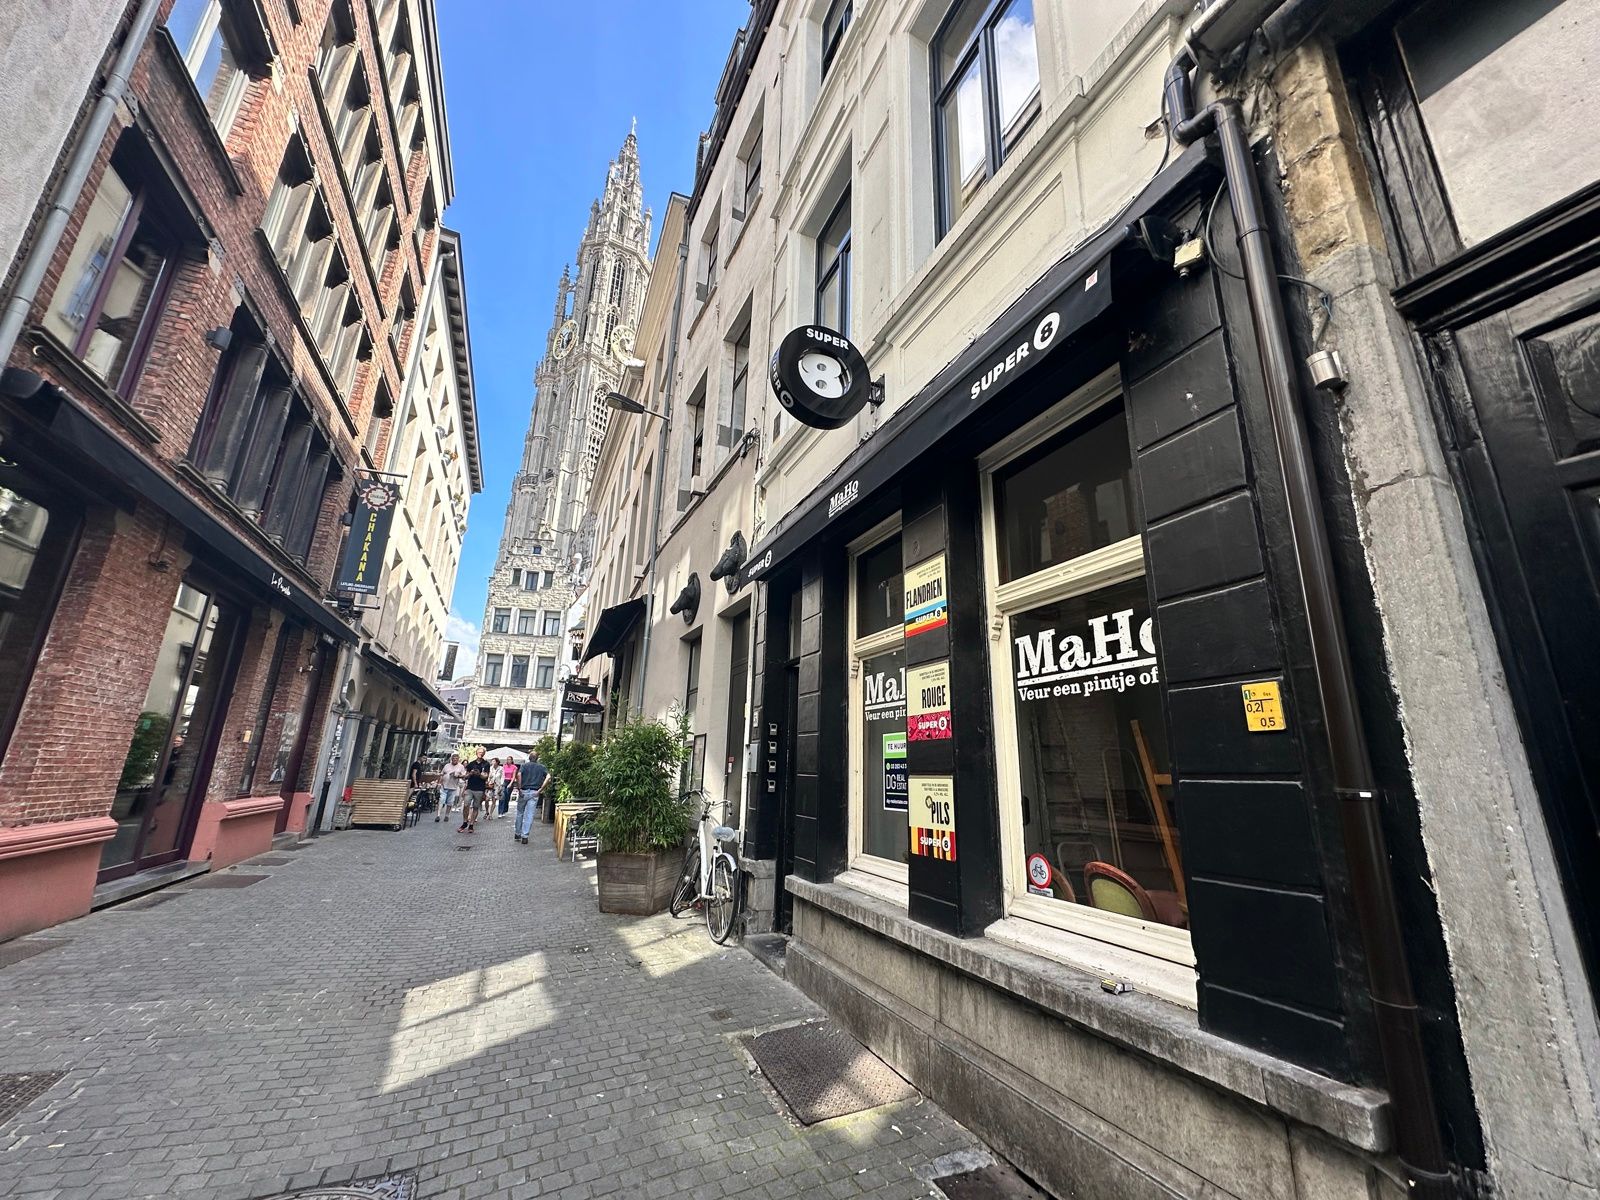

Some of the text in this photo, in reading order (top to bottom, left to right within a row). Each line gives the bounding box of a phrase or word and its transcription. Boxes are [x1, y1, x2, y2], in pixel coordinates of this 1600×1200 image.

[806, 328, 850, 350] SUPER
[970, 342, 1030, 400] SUPER
[829, 480, 859, 511] MaHo
[355, 513, 378, 582] CHAKANA
[748, 559, 765, 578] SUPER
[906, 577, 943, 609] FLANDRIEN
[915, 612, 935, 623] SUPER
[865, 667, 906, 705] Ma
[1018, 665, 1159, 701] Veur een pintje of
[921, 684, 947, 709] ROUGE
[1246, 702, 1262, 713] 0,2
[865, 711, 881, 721] Veur
[881, 710, 894, 719] een
[918, 720, 938, 730] SUPER
[1260, 717, 1276, 728] 0,5
[886, 774, 896, 790] DG
[931, 801, 950, 826] PILS
[920, 836, 941, 847] SUPER
